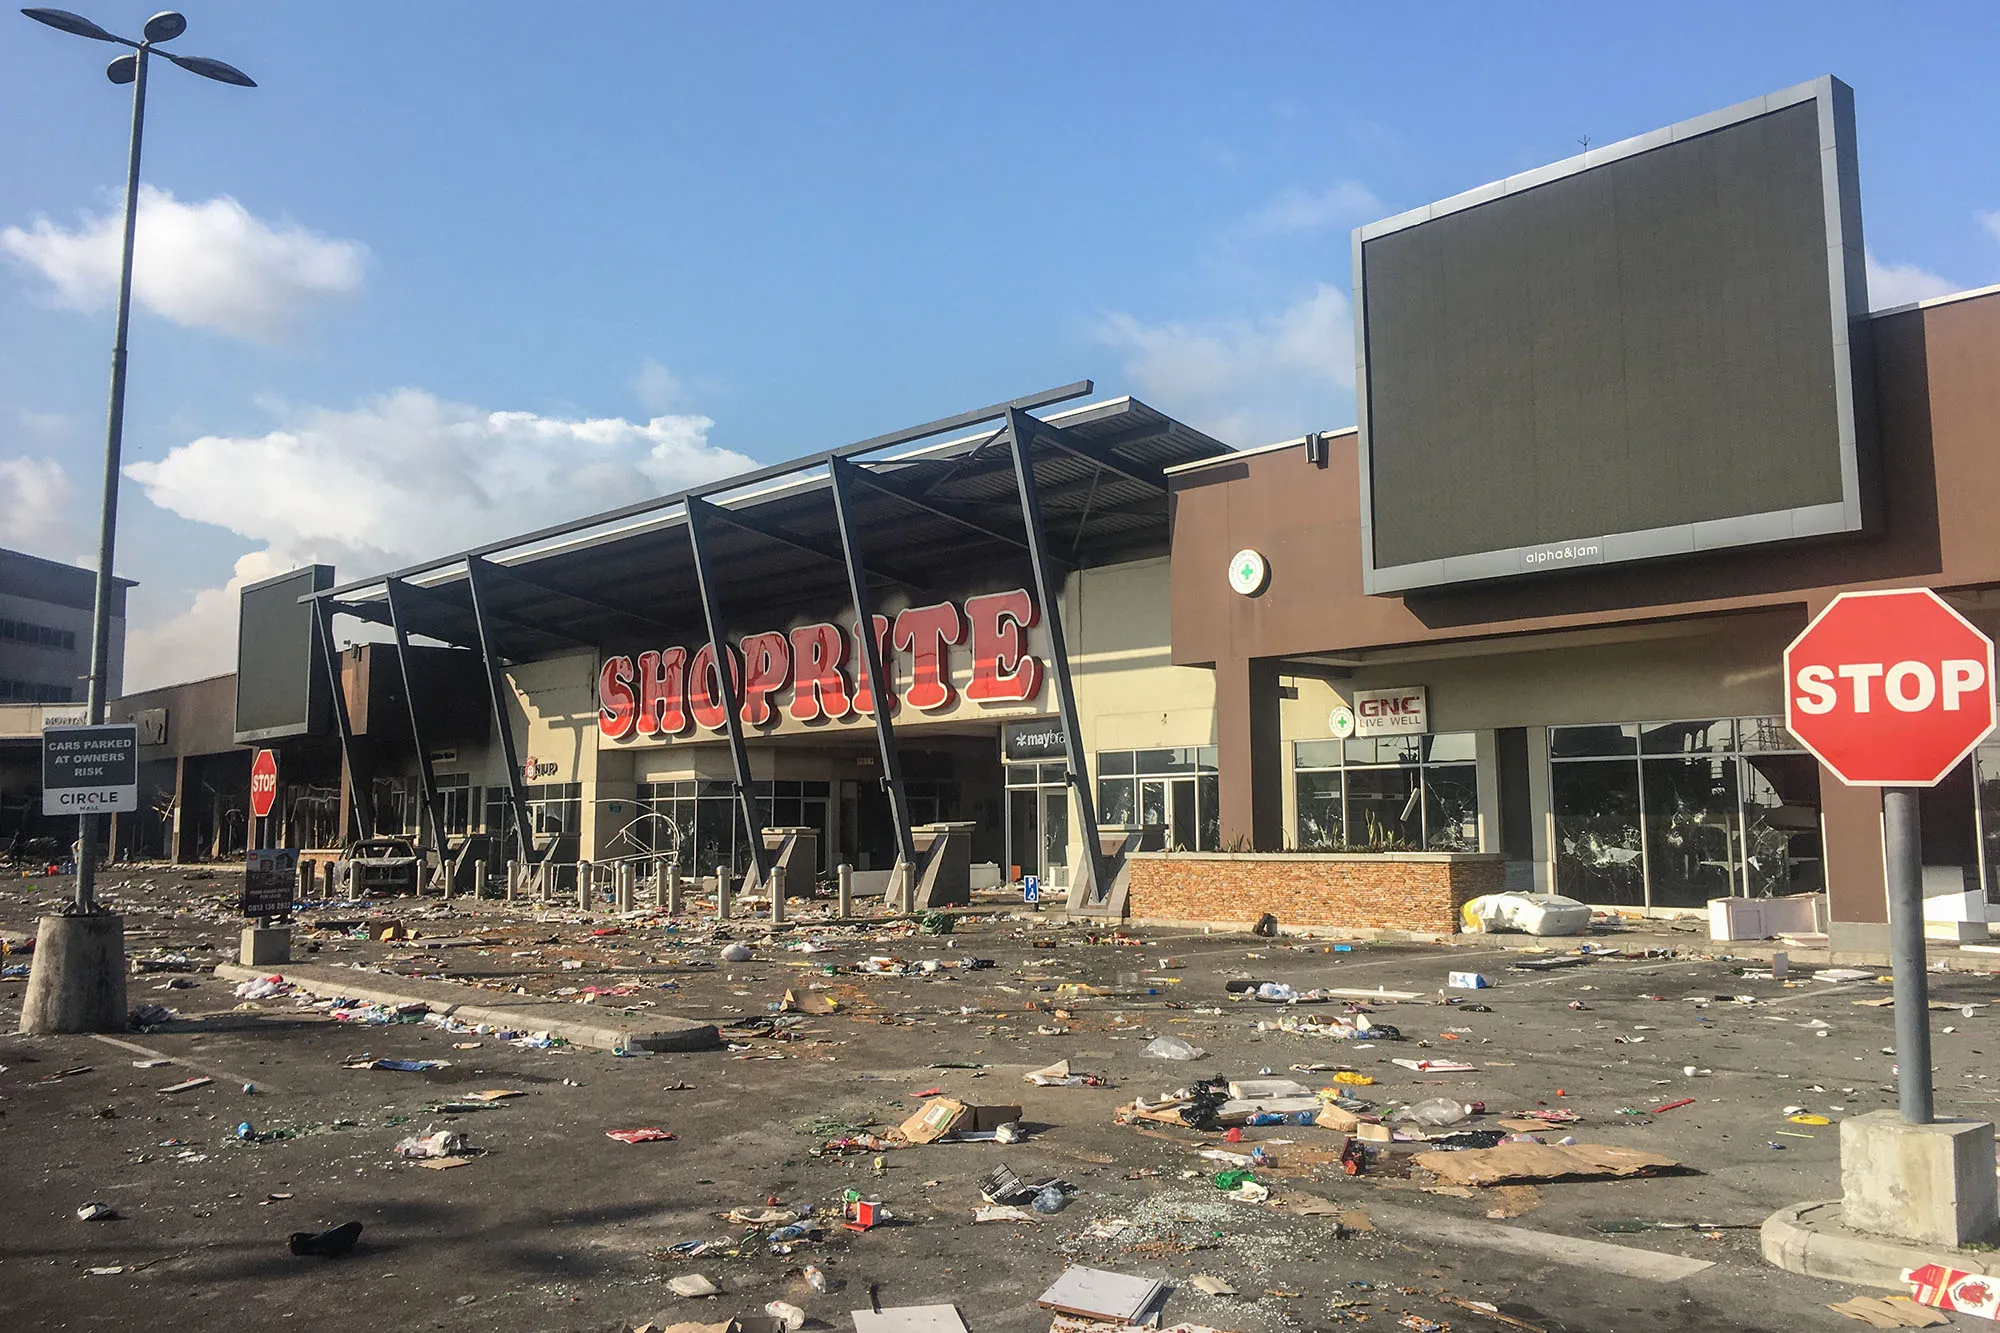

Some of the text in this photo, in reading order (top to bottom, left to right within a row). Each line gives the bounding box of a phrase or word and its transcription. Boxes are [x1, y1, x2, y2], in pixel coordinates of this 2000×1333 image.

[1526, 545, 1598, 563] alpha&jam
[1796, 659, 1985, 715] STOP
[1359, 696, 1421, 717] GNC
[1359, 718, 1384, 728] LIVE
[1390, 715, 1421, 726] WELL
[48, 739, 132, 751] CARS PARKED
[54, 753, 125, 765] AT OWNERS
[74, 767, 104, 776] RISK
[252, 774, 276, 792] STOP
[60, 791, 118, 805] CIRCLE
[1028, 877, 1035, 889] P
